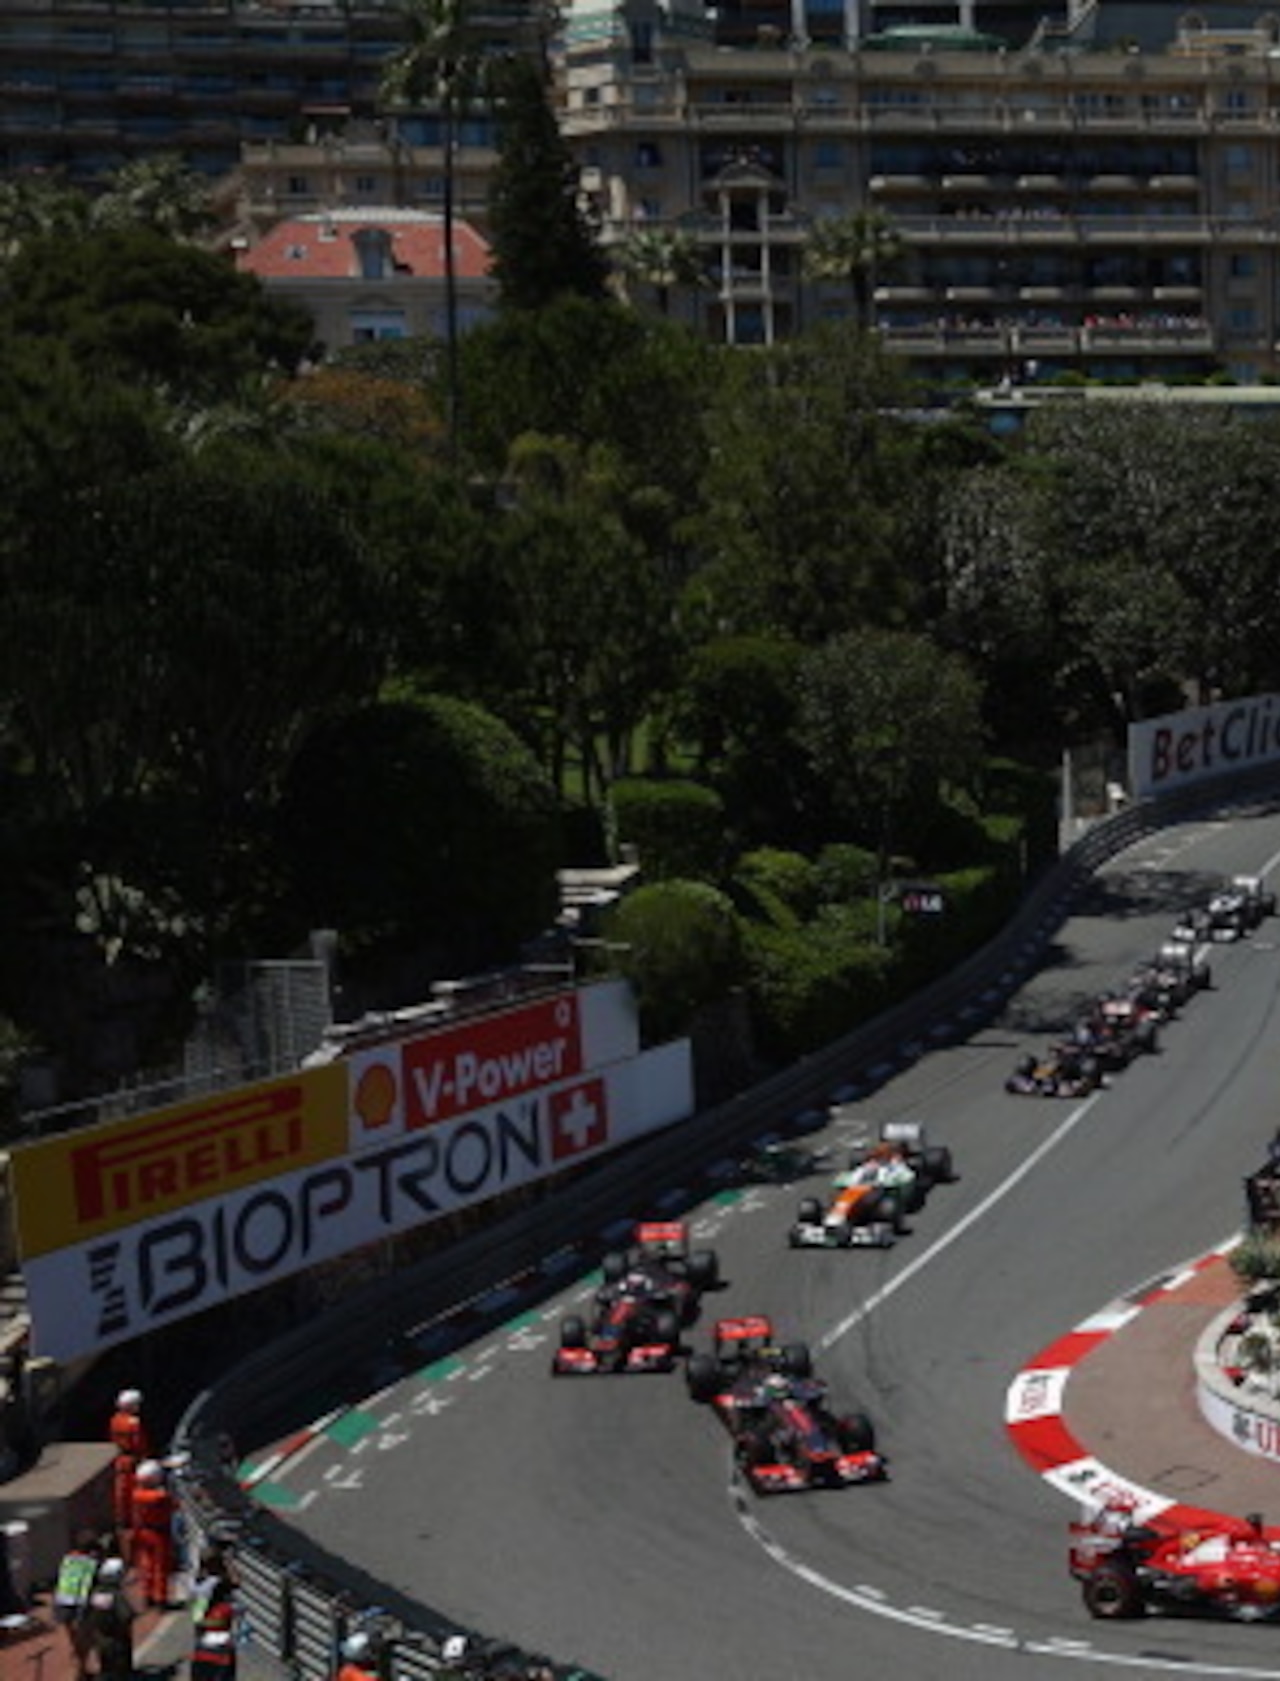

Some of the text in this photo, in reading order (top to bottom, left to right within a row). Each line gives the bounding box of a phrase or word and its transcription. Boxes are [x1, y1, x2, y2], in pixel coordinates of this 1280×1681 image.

[413, 1036, 566, 1117] V-Power
[68, 1086, 302, 1224] PIRELLI
[136, 1098, 544, 1318] BIOPTRON
